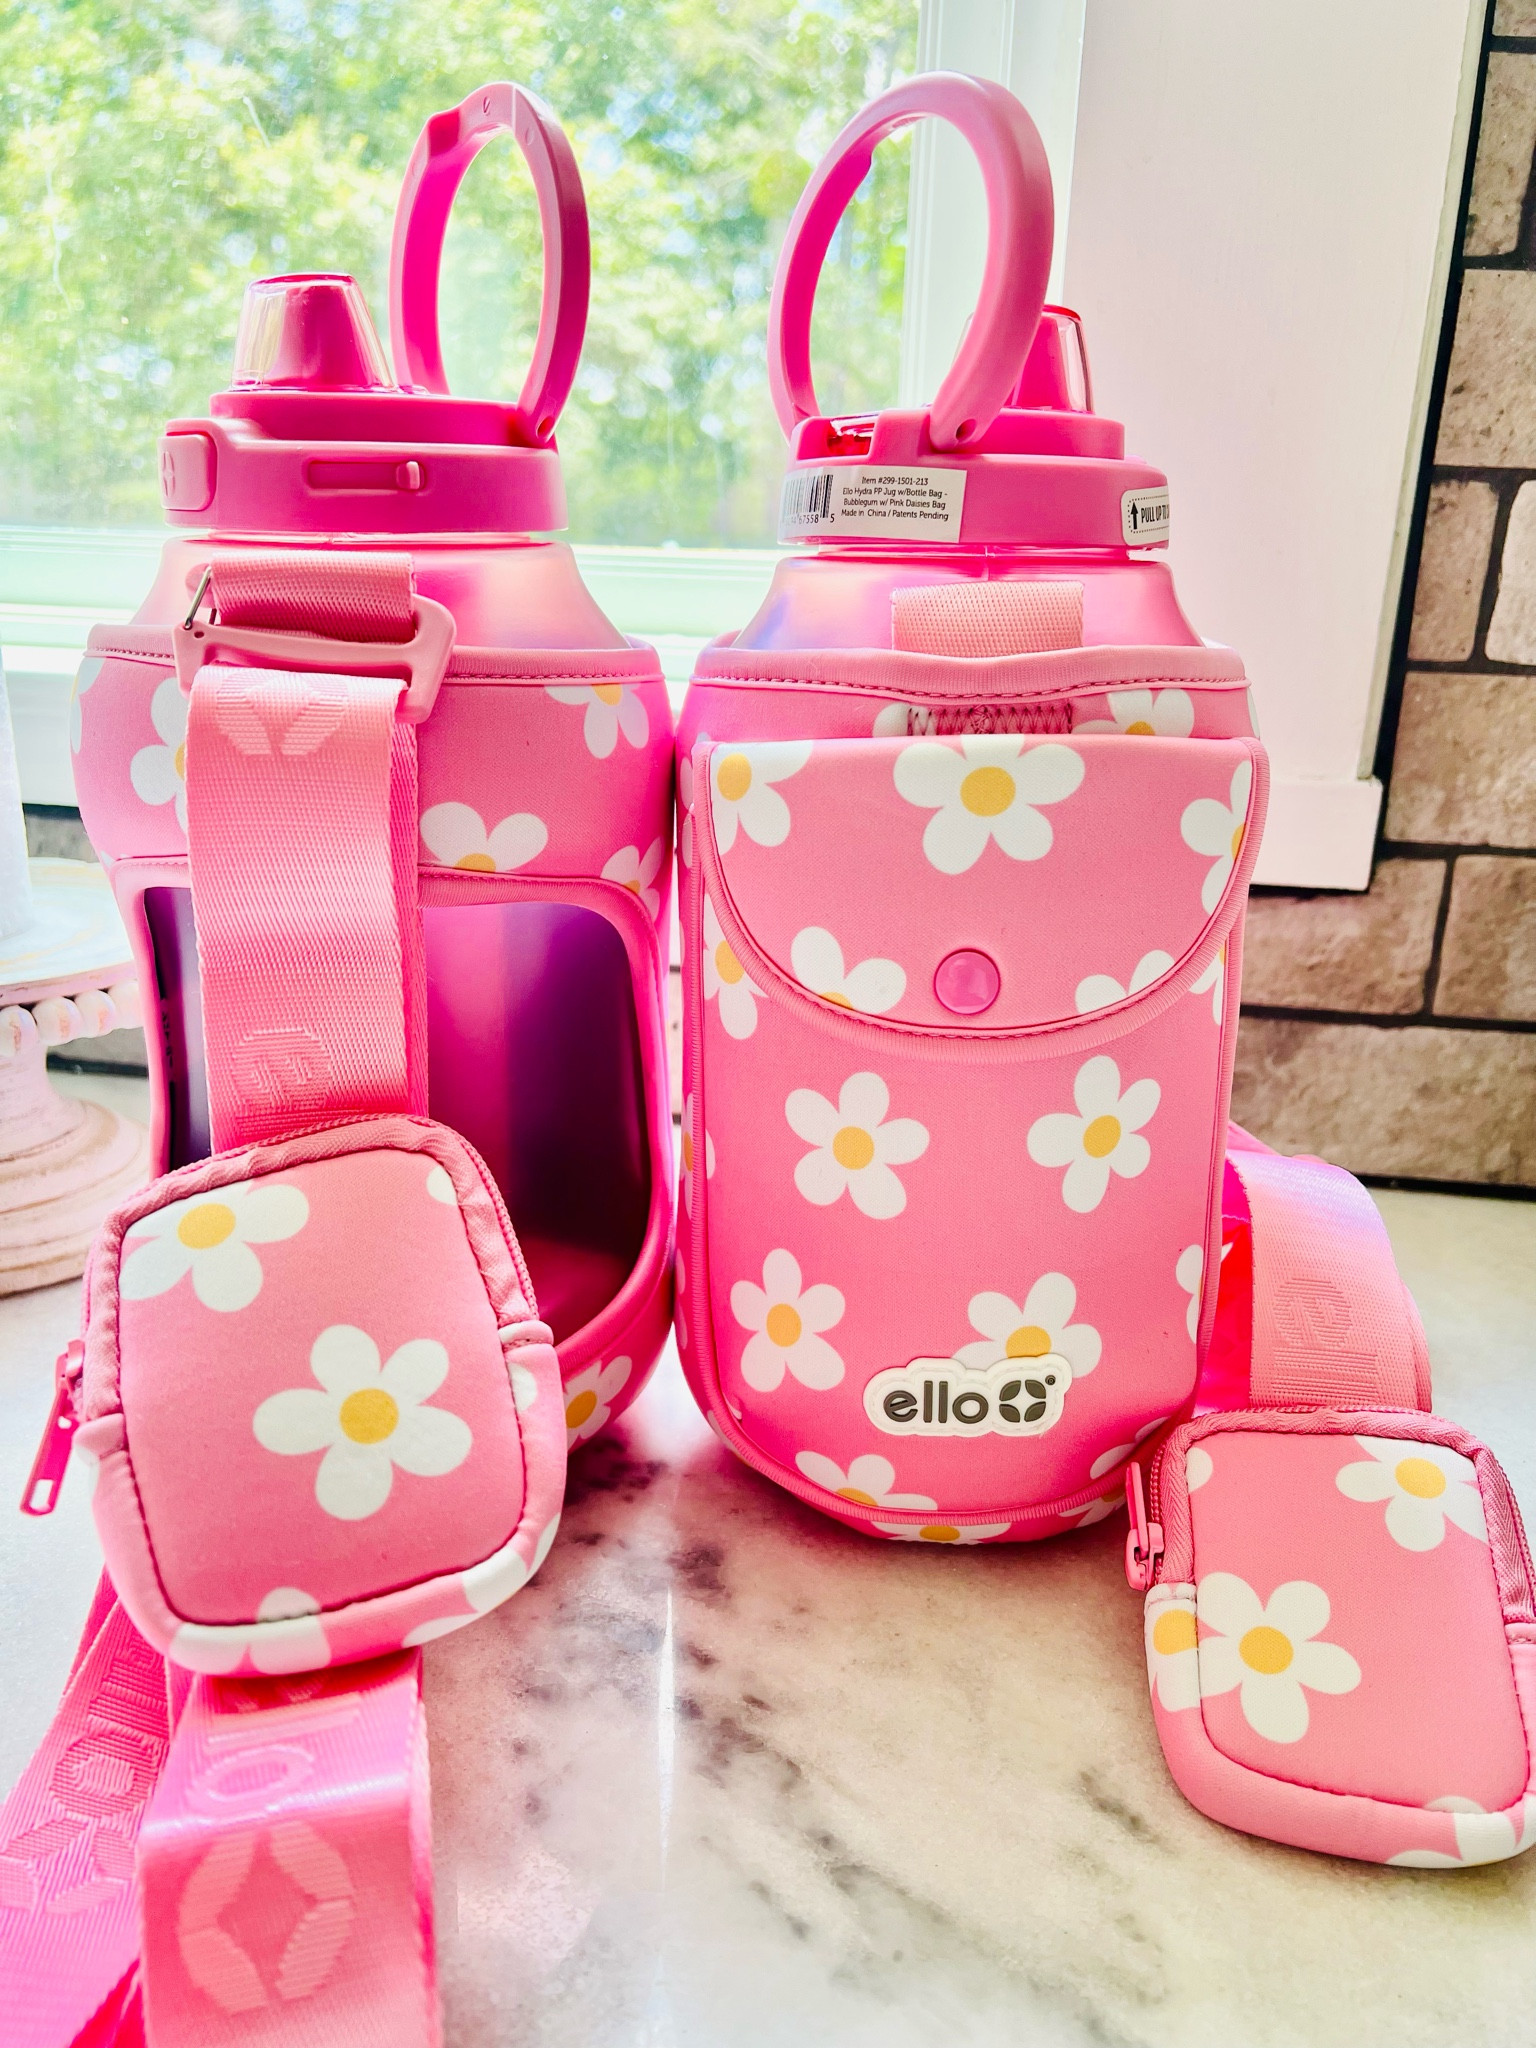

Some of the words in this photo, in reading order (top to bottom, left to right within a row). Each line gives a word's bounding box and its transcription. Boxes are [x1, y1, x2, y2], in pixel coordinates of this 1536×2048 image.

[861, 476, 876, 485] Item
[878, 476, 929, 486] #299-1501-213
[842, 487, 853, 495] Ello
[854, 487, 873, 497] Hydra
[874, 487, 882, 495] PP
[883, 487, 896, 497] Jug
[897, 488, 927, 497] w/Bottle
[928, 489, 943, 500] Bag
[843, 498, 878, 508] Bubblegum
[880, 498, 888, 506] w/
[890, 498, 904, 507] Pink
[905, 499, 930, 508] Daisies
[932, 500, 946, 511] Bag
[841, 509, 857, 517] Made
[859, 509, 865, 517] in
[867, 508, 887, 517] China
[892, 510, 918, 518] Patents
[919, 511, 949, 522] Pending
[1141, 506, 1155, 524] PULL
[883, 1380, 989, 1424] ello
